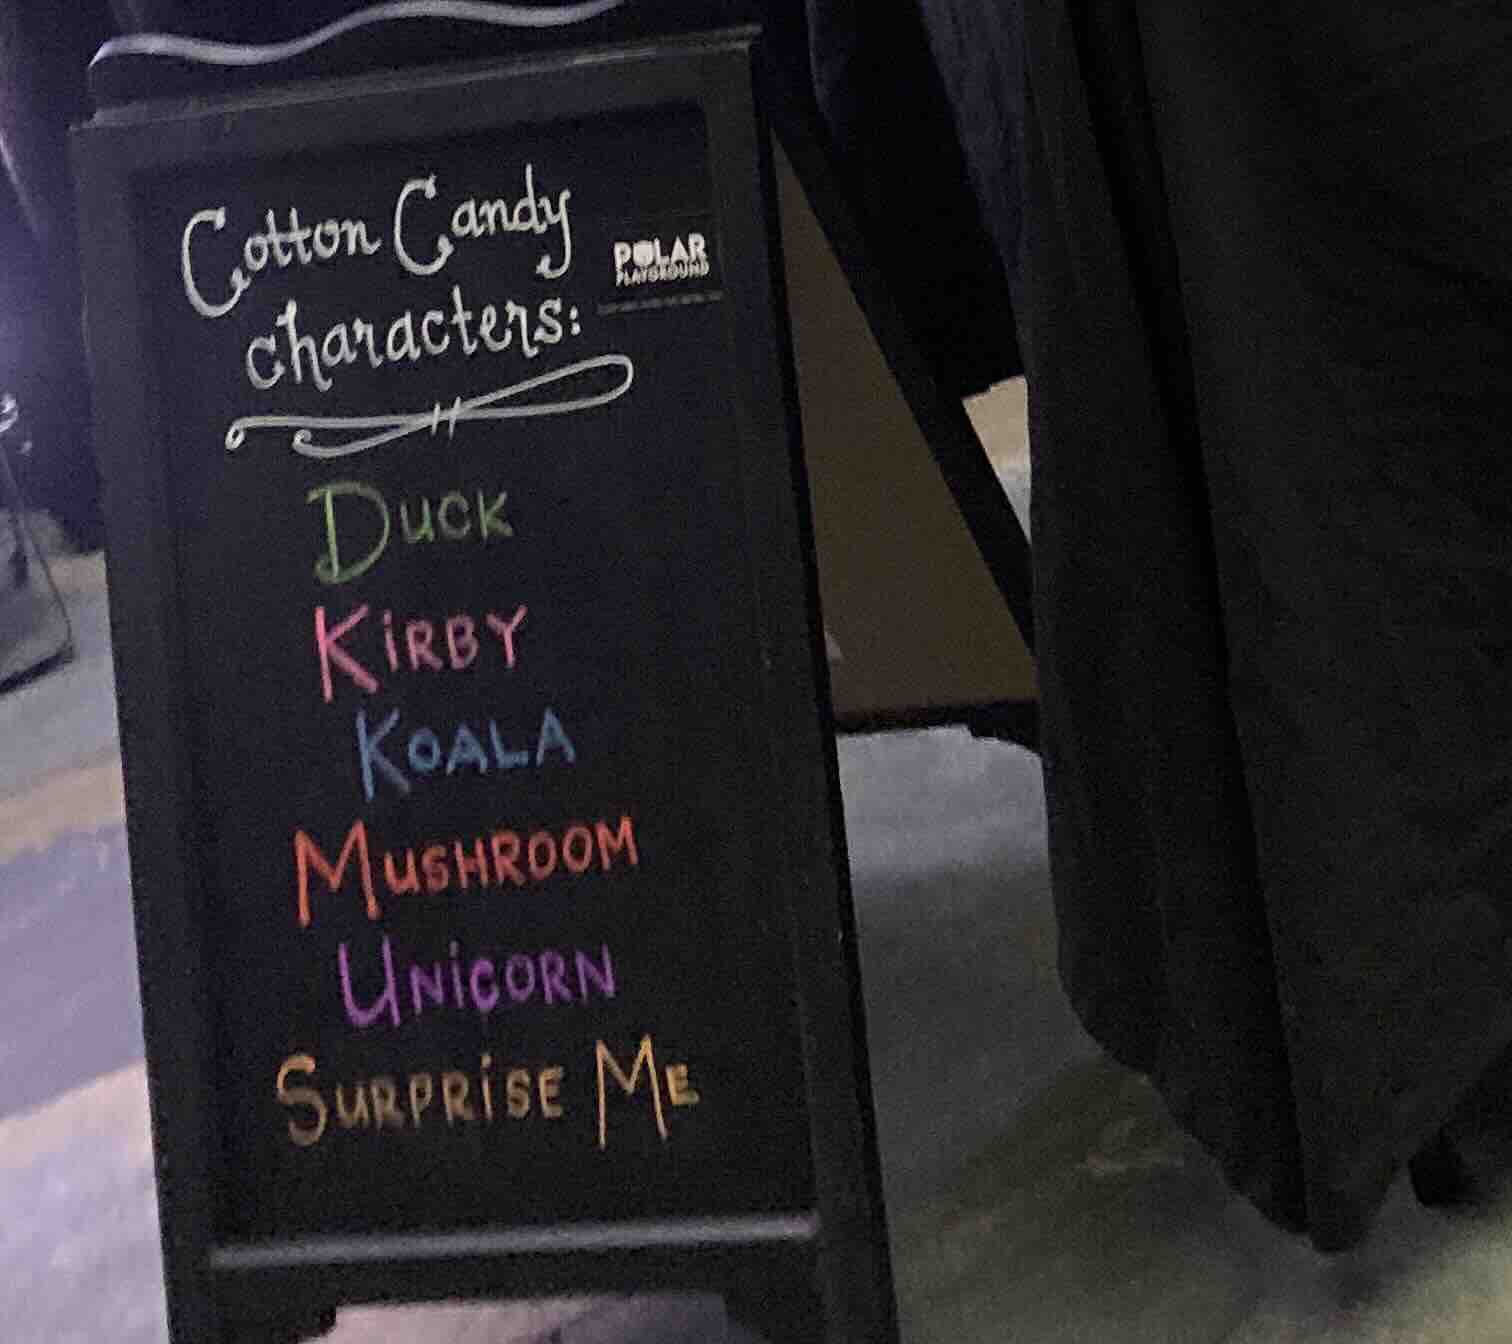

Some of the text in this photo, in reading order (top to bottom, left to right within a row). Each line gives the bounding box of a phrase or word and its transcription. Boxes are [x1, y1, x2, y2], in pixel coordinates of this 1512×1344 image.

[181, 163, 571, 318] Cotton Candy
[613, 233, 705, 274] POLAR
[355, 707, 577, 802] KOALA
[293, 816, 639, 928] MUSHROOM
